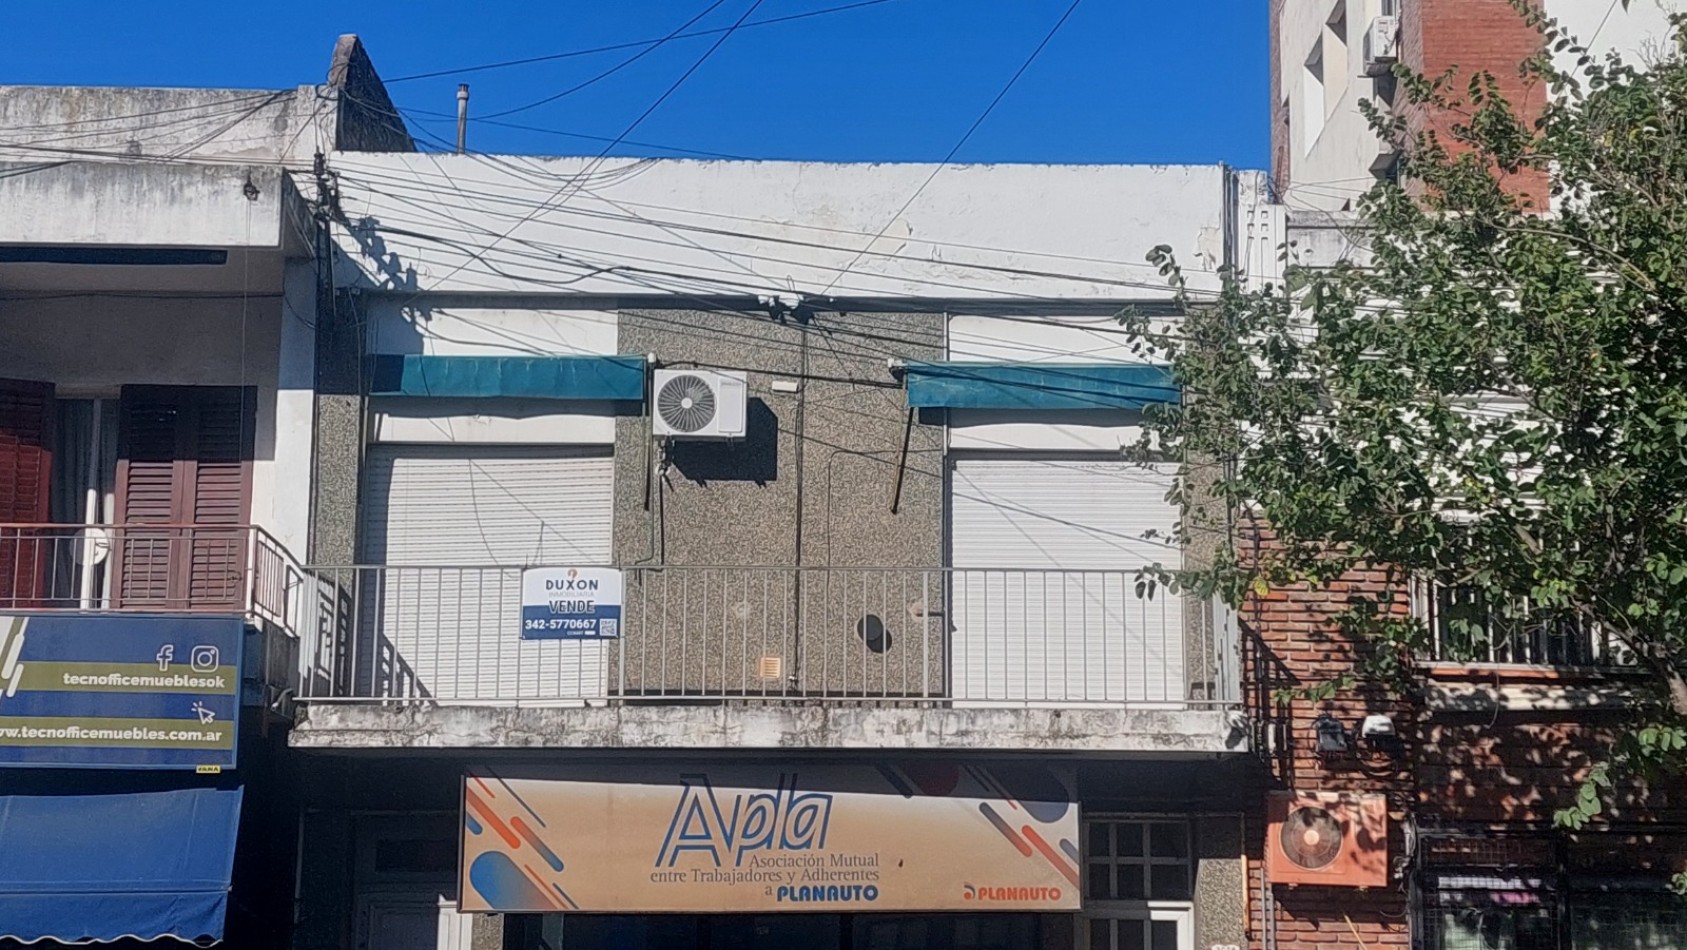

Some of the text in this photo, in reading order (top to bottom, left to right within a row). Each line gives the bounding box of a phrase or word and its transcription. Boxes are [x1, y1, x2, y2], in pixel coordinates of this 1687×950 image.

[546, 580, 598, 590] DUXON
[548, 600, 595, 614] VENDE
[525, 619, 597, 630] 342-5770667
[63, 673, 225, 688] tecnofficemueblesok
[654, 773, 834, 868] Apla
[748, 853, 879, 868] Asociación Mutual
[650, 868, 880, 886] entre Trabajadores y Adherentes
[764, 884, 879, 902] a PLANAUTO
[978, 887, 1062, 901] PLANAUTO
